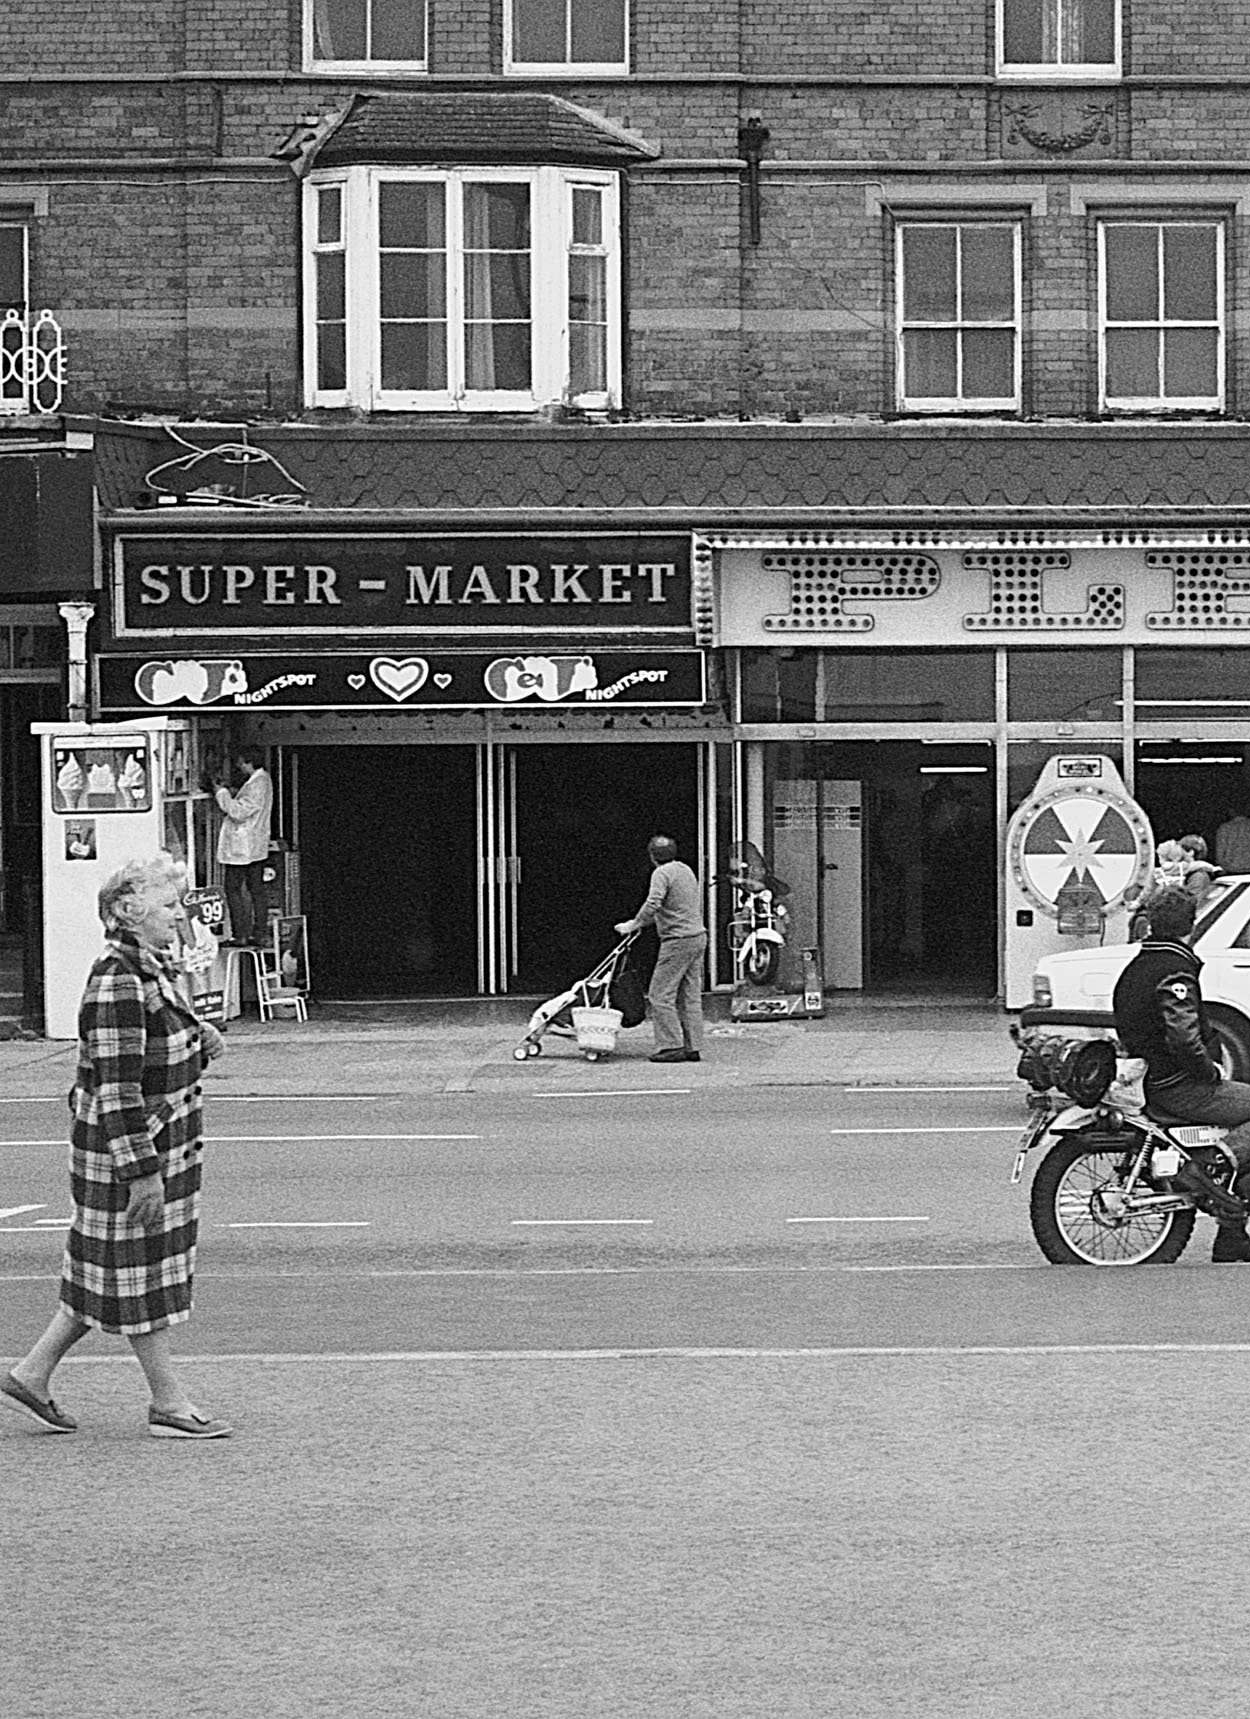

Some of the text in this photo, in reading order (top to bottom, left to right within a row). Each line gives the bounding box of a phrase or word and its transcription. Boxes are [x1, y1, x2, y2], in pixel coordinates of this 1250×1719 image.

[140, 565, 341, 605] SUPER
[406, 563, 676, 605] MARKET
[234, 674, 317, 705] NIGHTSPOT
[585, 670, 669, 701] NIGHTSPOT
